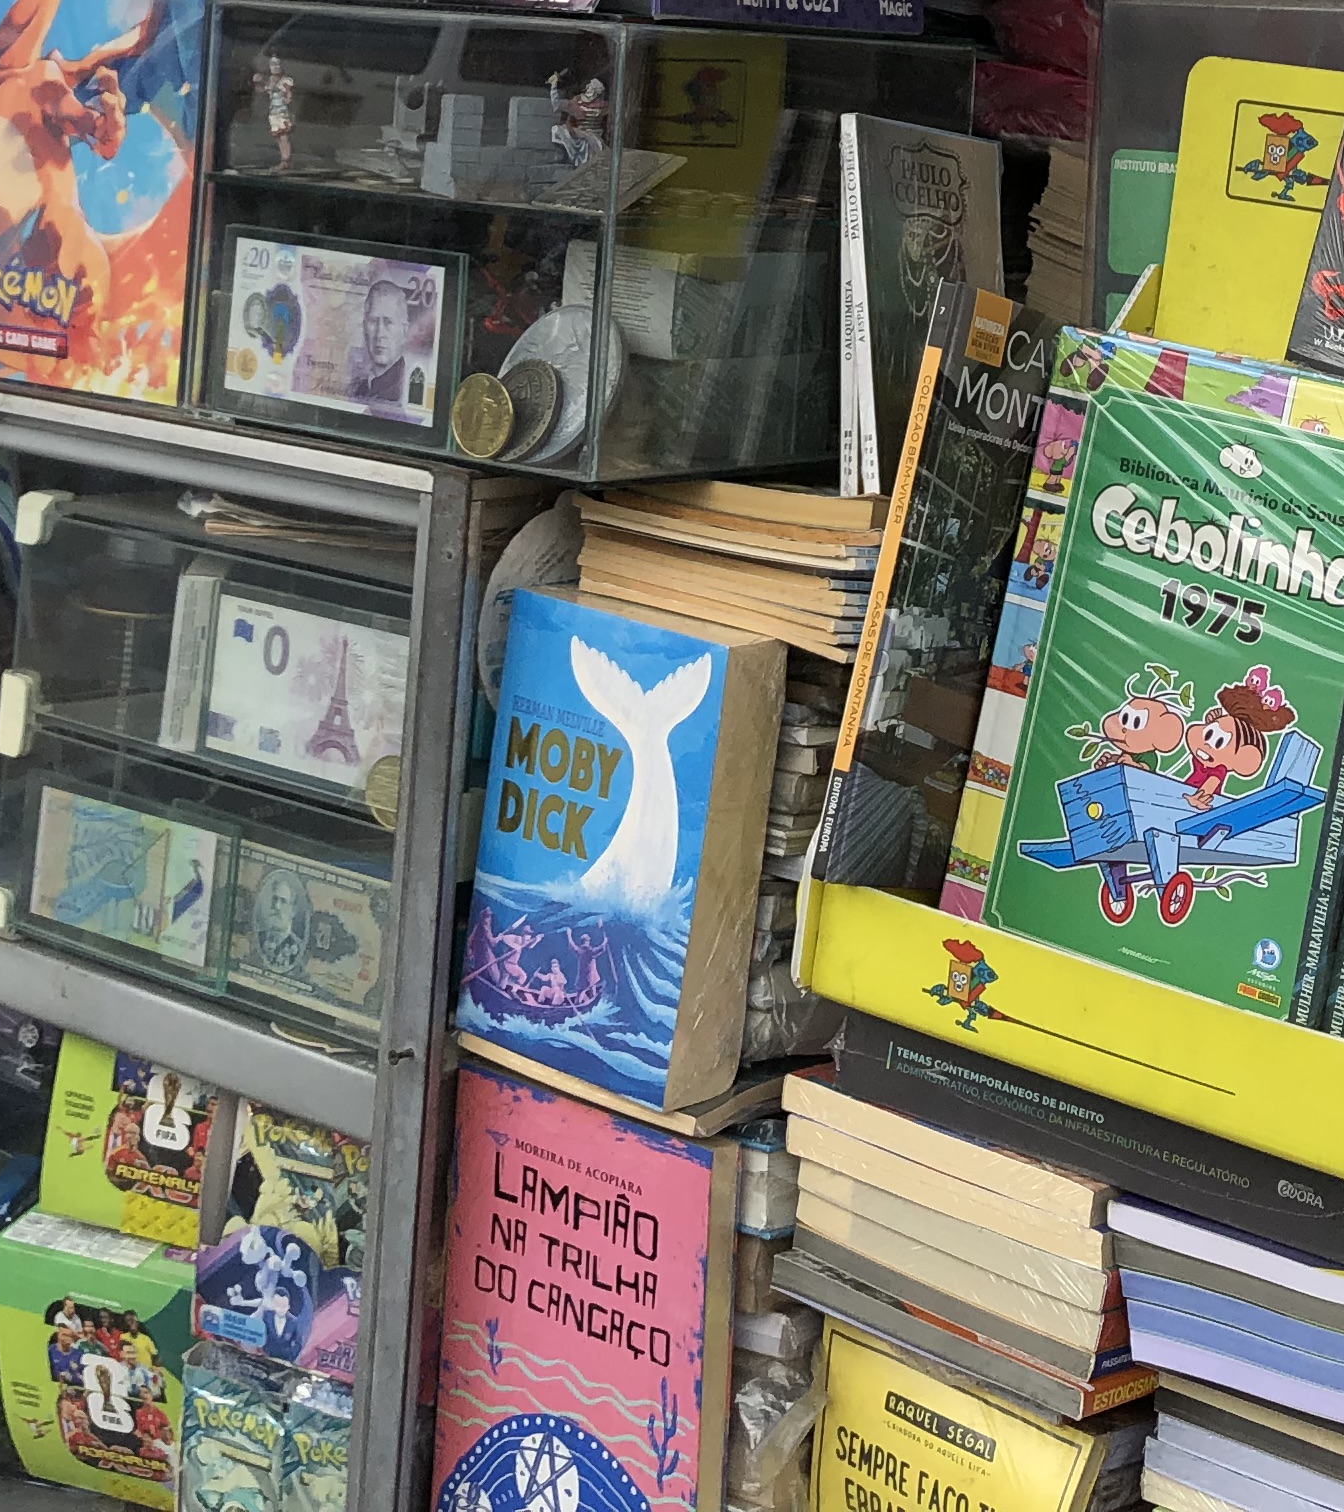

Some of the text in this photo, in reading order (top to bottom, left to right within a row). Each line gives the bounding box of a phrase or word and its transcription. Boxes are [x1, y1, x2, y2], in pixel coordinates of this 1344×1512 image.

[895, 182, 959, 211] COELHO
[901, 159, 951, 187] PAULO
[1119, 458, 1199, 491] Biblioteca
[1282, 499, 1302, 516] de
[1160, 578, 1266, 644] 1975
[842, 590, 885, 748] CASAS MONTANHA
[504, 716, 624, 799] MOBY
[497, 780, 594, 860] DICK
[896, 1047, 1105, 1124] TEMAS CONTEMPORÂNEOS DE DIREITO
[514, 1139, 643, 1196] MOREIRA DE ACOPIARA
[490, 1213, 657, 1308] NA TRILHA
[475, 1257, 670, 1367] DO CANGAÇO
[835, 1426, 909, 1496] SEMPRE
[888, 1394, 995, 1459] RAQUEL SEGAL
